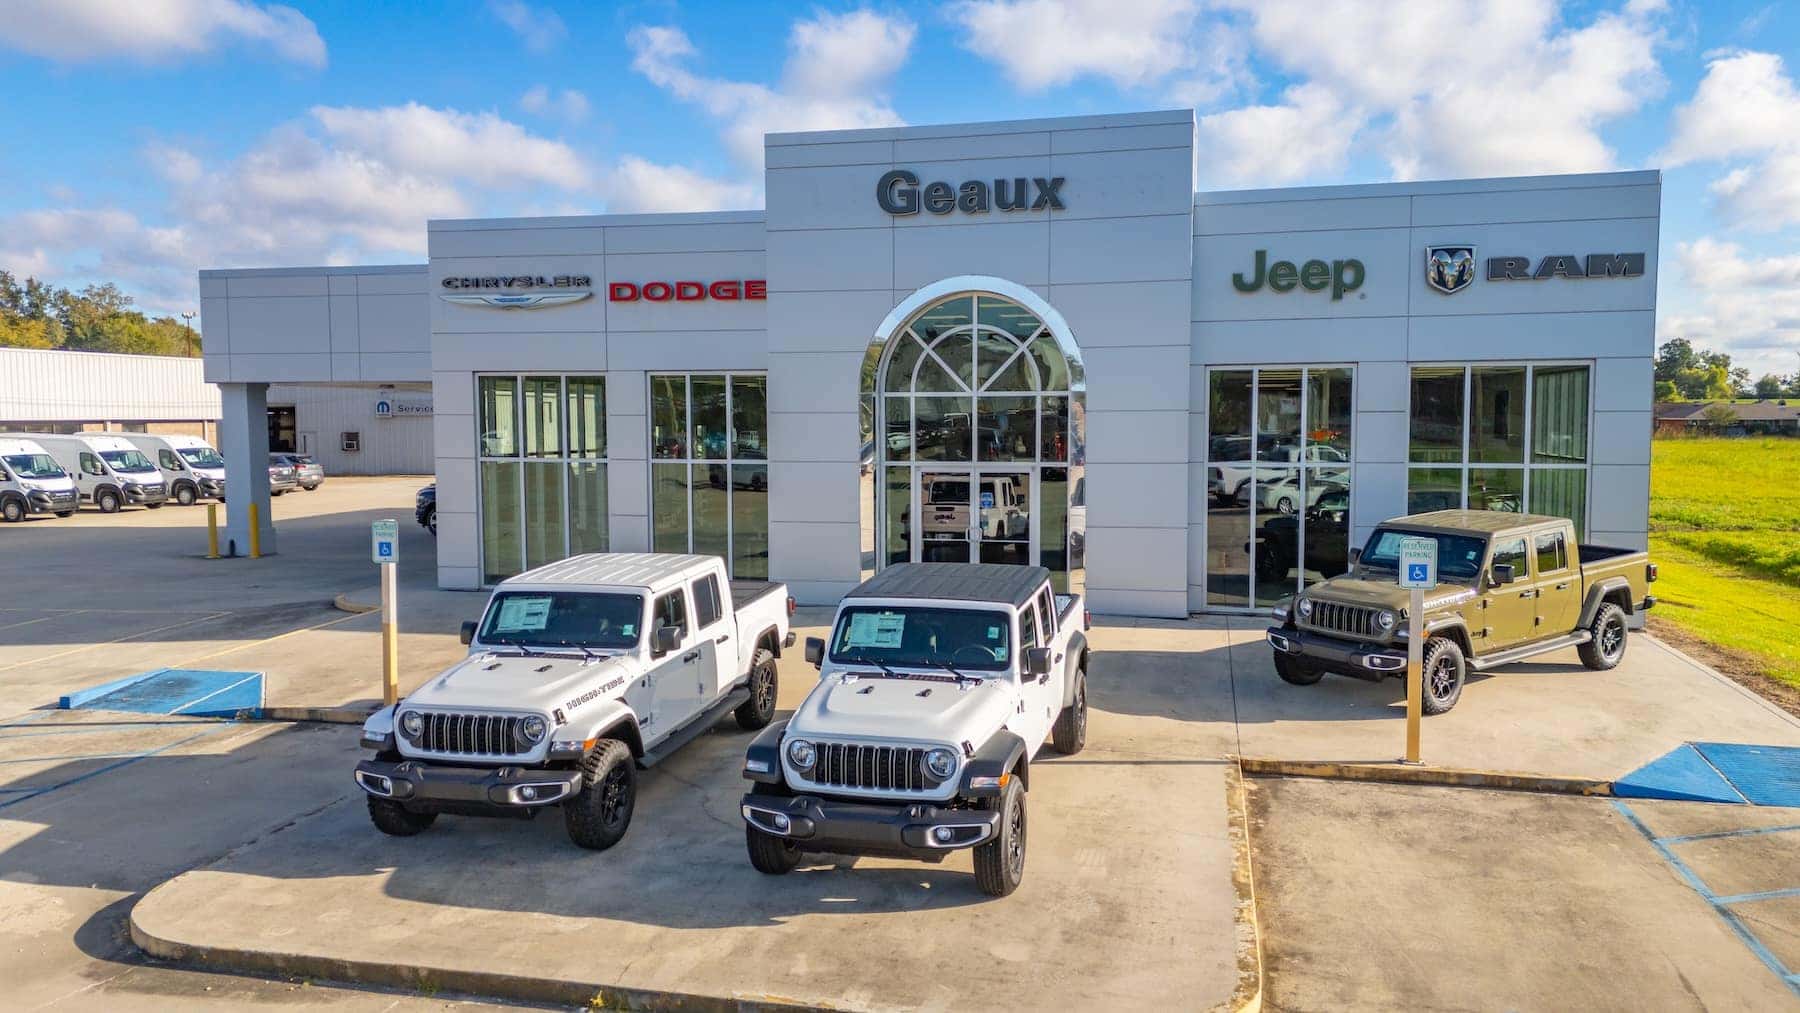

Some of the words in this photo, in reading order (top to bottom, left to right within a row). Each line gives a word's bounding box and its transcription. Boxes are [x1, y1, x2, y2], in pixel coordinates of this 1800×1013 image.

[877, 169, 1065, 215] Geaux
[1232, 249, 1365, 301] Jeep
[1487, 252, 1645, 281] RAM
[441, 275, 592, 289] CHRYSLER
[609, 280, 767, 302] DODGE
[1405, 551, 1433, 559] PARKING
